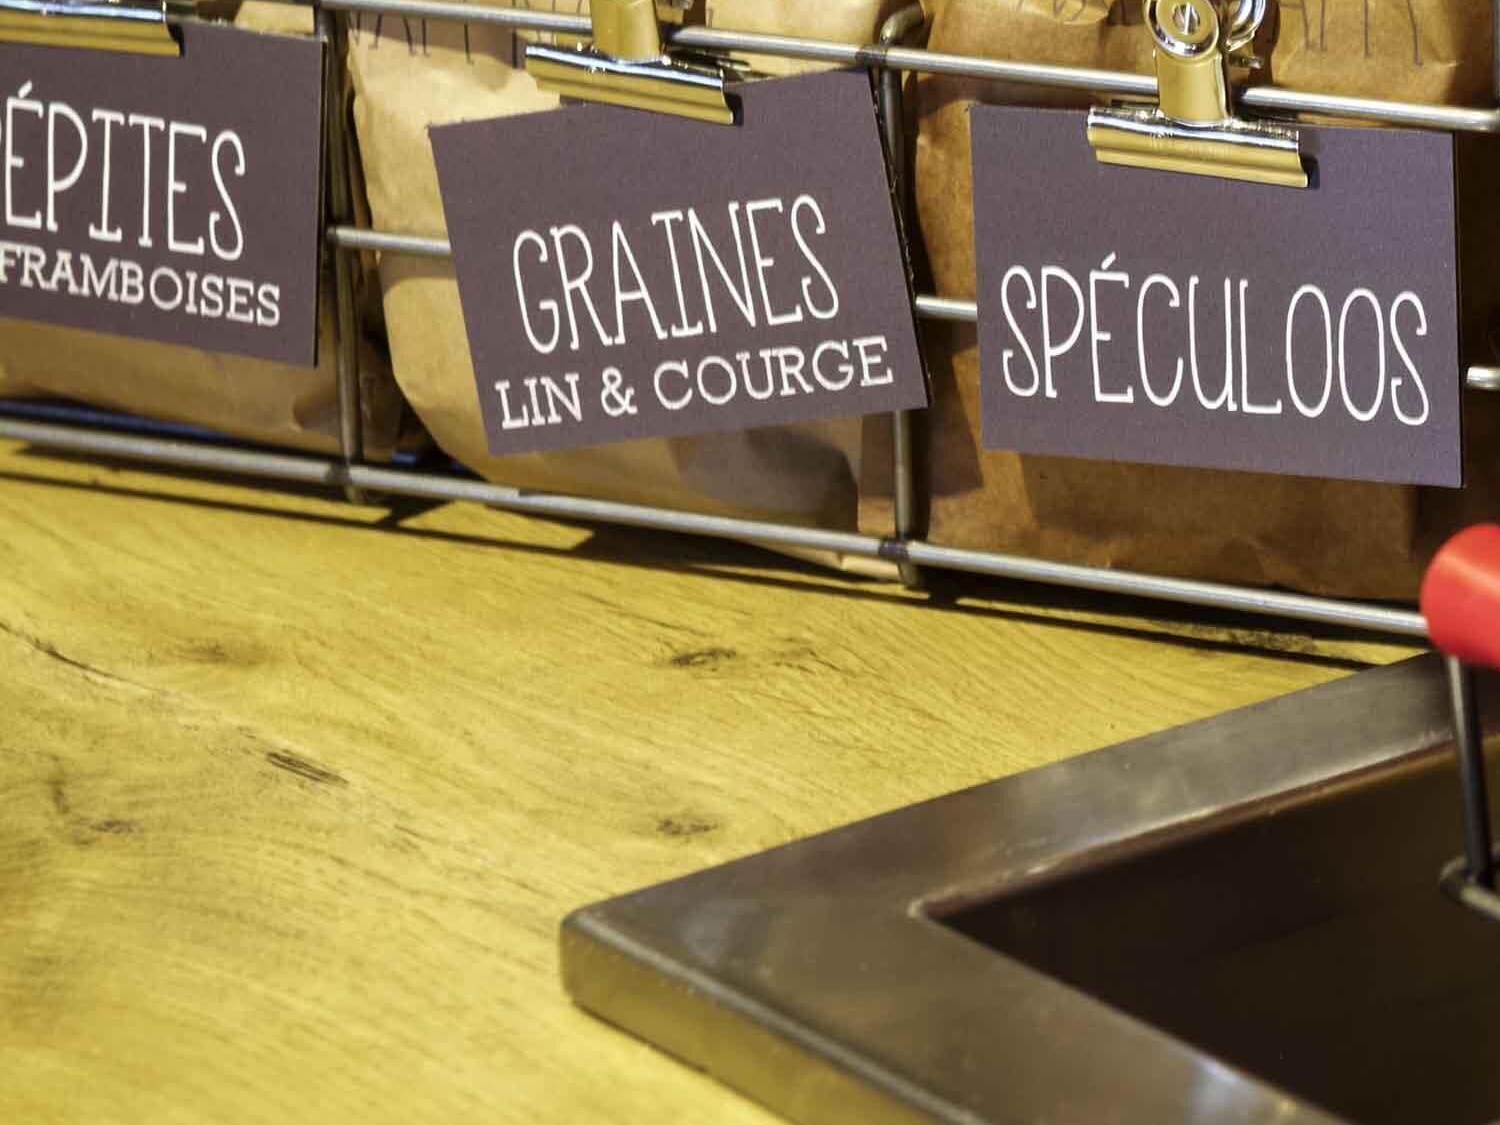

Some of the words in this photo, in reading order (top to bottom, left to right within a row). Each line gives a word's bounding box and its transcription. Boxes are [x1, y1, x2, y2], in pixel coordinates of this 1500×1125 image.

[0, 79, 246, 261] ÉPITES
[0, 240, 281, 327] FRAMBOISES
[512, 193, 840, 355] GRAINES
[1000, 251, 1430, 427] SPÉCULOOS
[494, 372, 583, 431] LIN
[600, 366, 639, 418] &
[652, 334, 895, 411] COURGE
